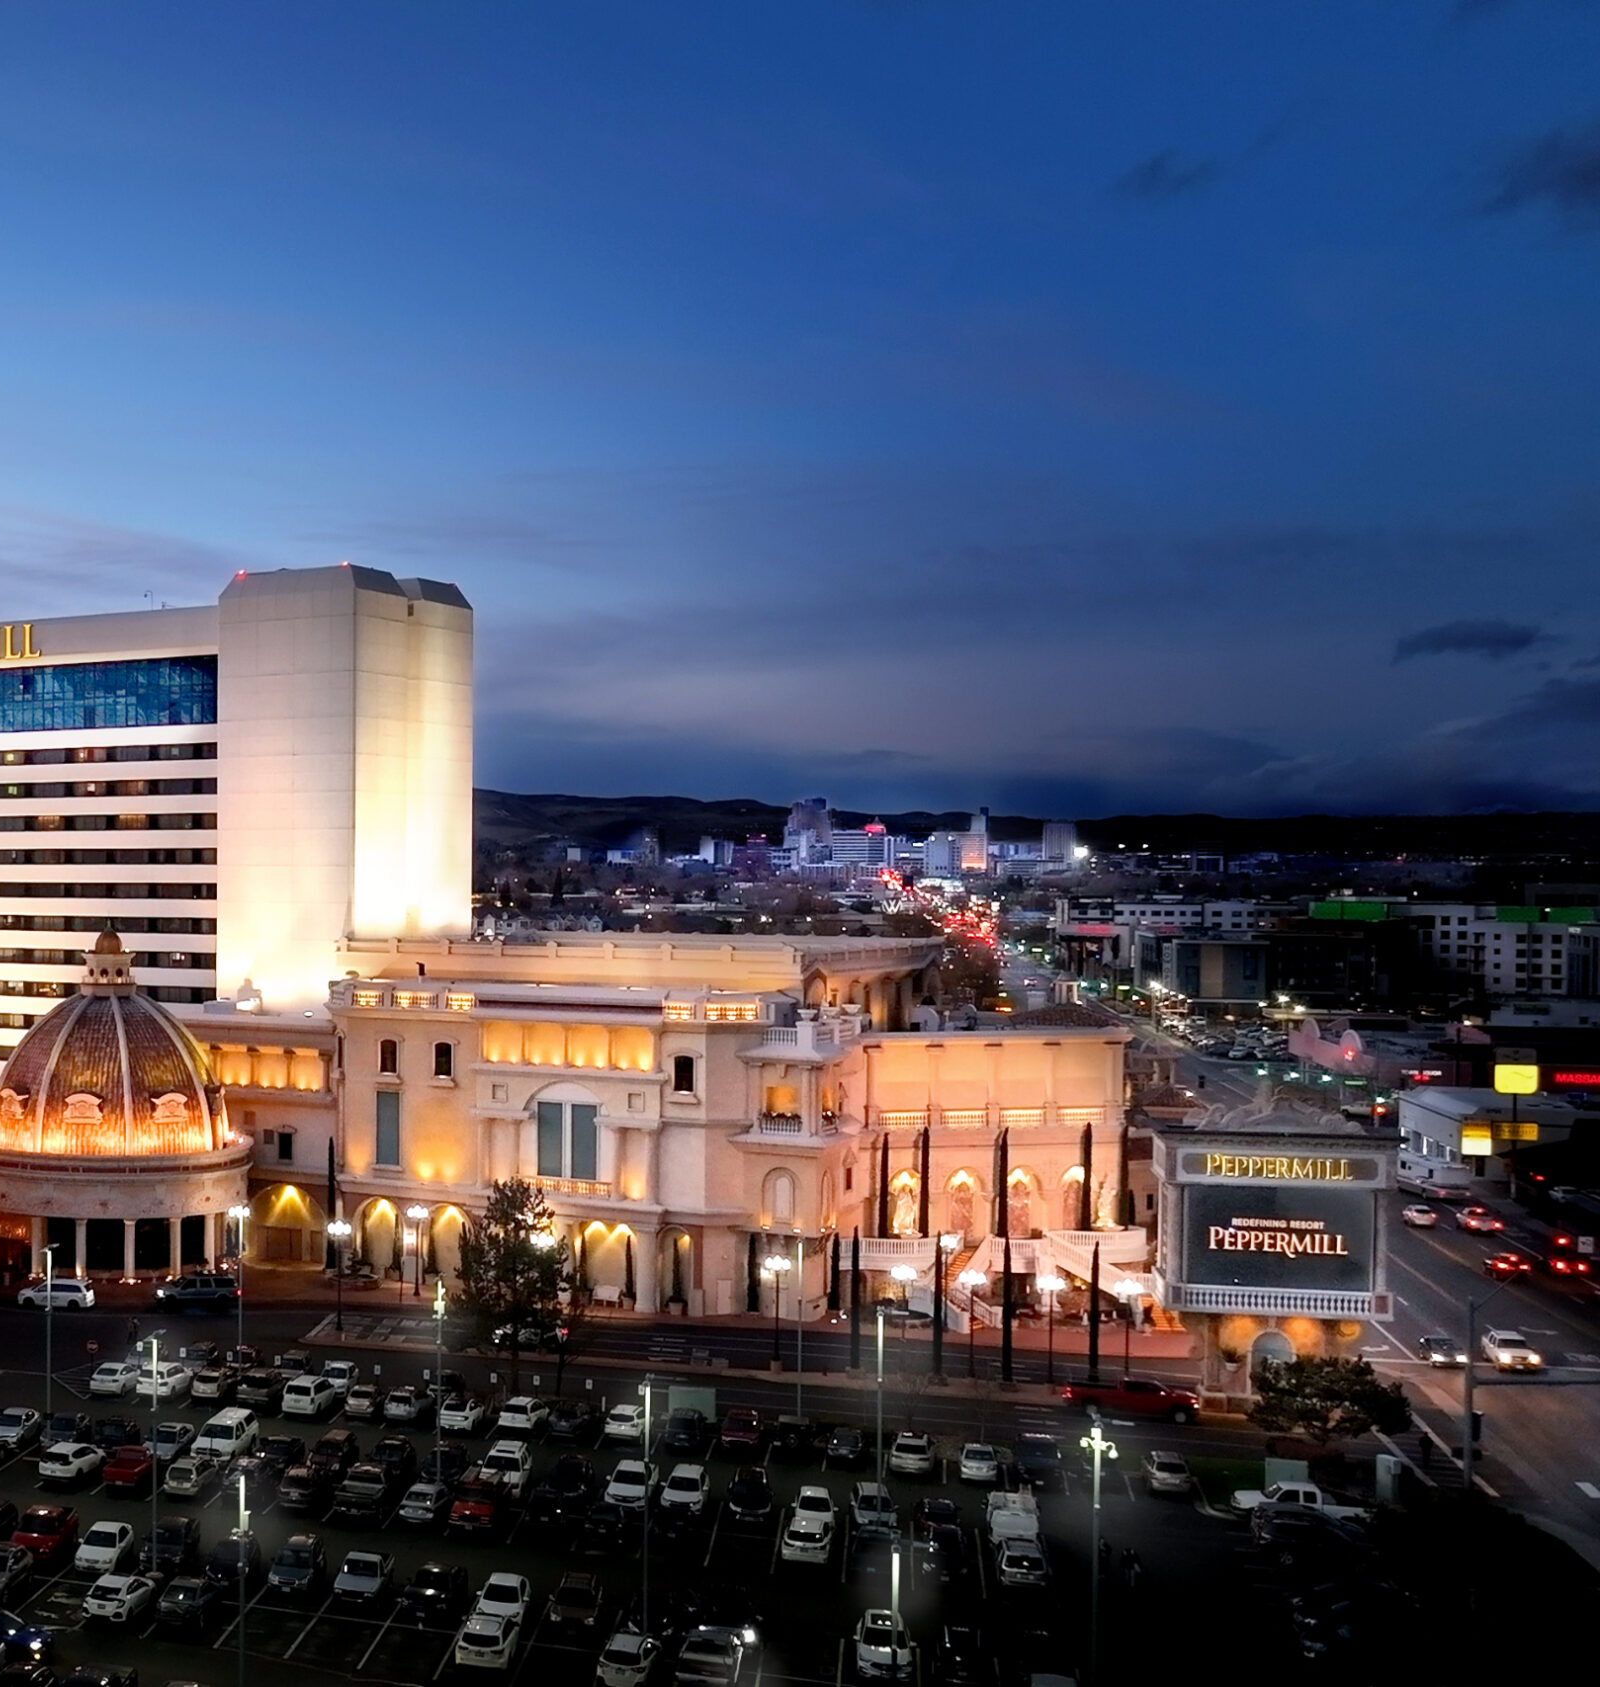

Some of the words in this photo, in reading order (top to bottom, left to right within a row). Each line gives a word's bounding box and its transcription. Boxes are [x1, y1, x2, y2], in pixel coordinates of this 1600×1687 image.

[1206, 1152, 1353, 1180] PEPPERMILL
[1231, 1217, 1287, 1228] REDEFINING
[1290, 1219, 1325, 1230] RESORT
[1208, 1226, 1349, 1258] PEPPERMILL
